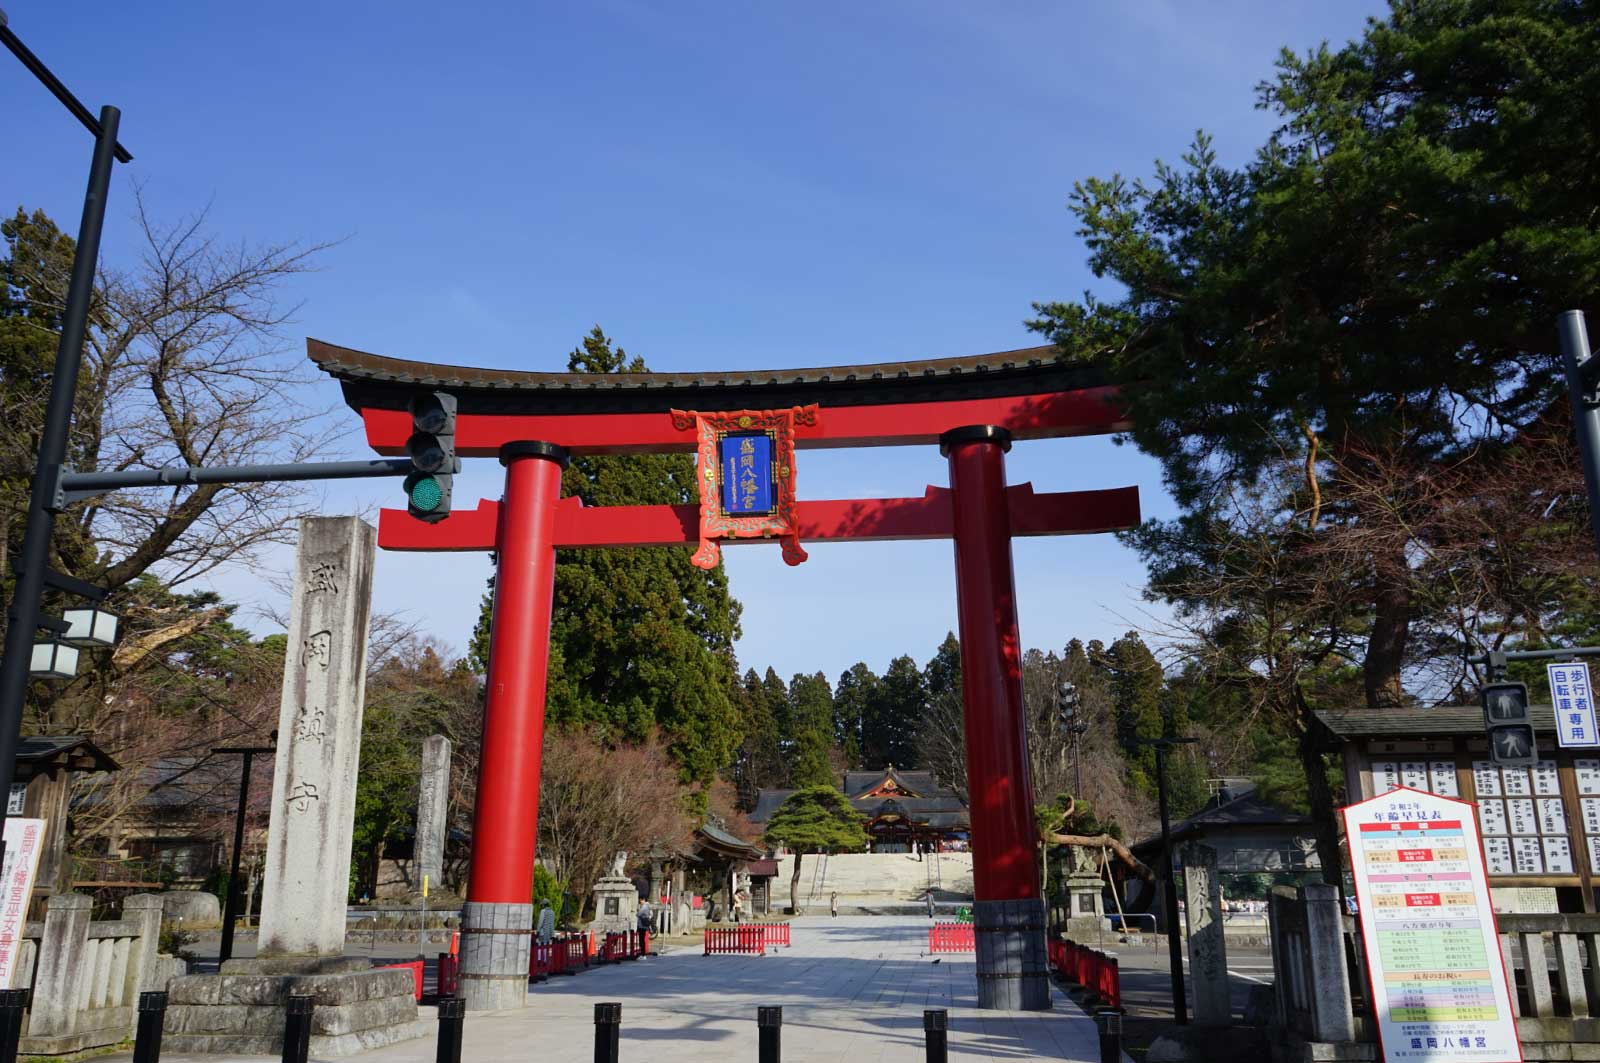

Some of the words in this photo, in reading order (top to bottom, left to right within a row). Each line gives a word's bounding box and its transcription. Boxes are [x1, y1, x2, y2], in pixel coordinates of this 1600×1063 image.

[739, 438, 759, 509] 盛岡八幡宮
[1554, 671, 1572, 710] 自転車
[1570, 670, 1587, 710] 歩行者
[1568, 713, 1585, 739] 専用
[1374, 810, 1442, 822] 年齢早見表
[1410, 1036, 1487, 1049] 盛岡八幡宮
